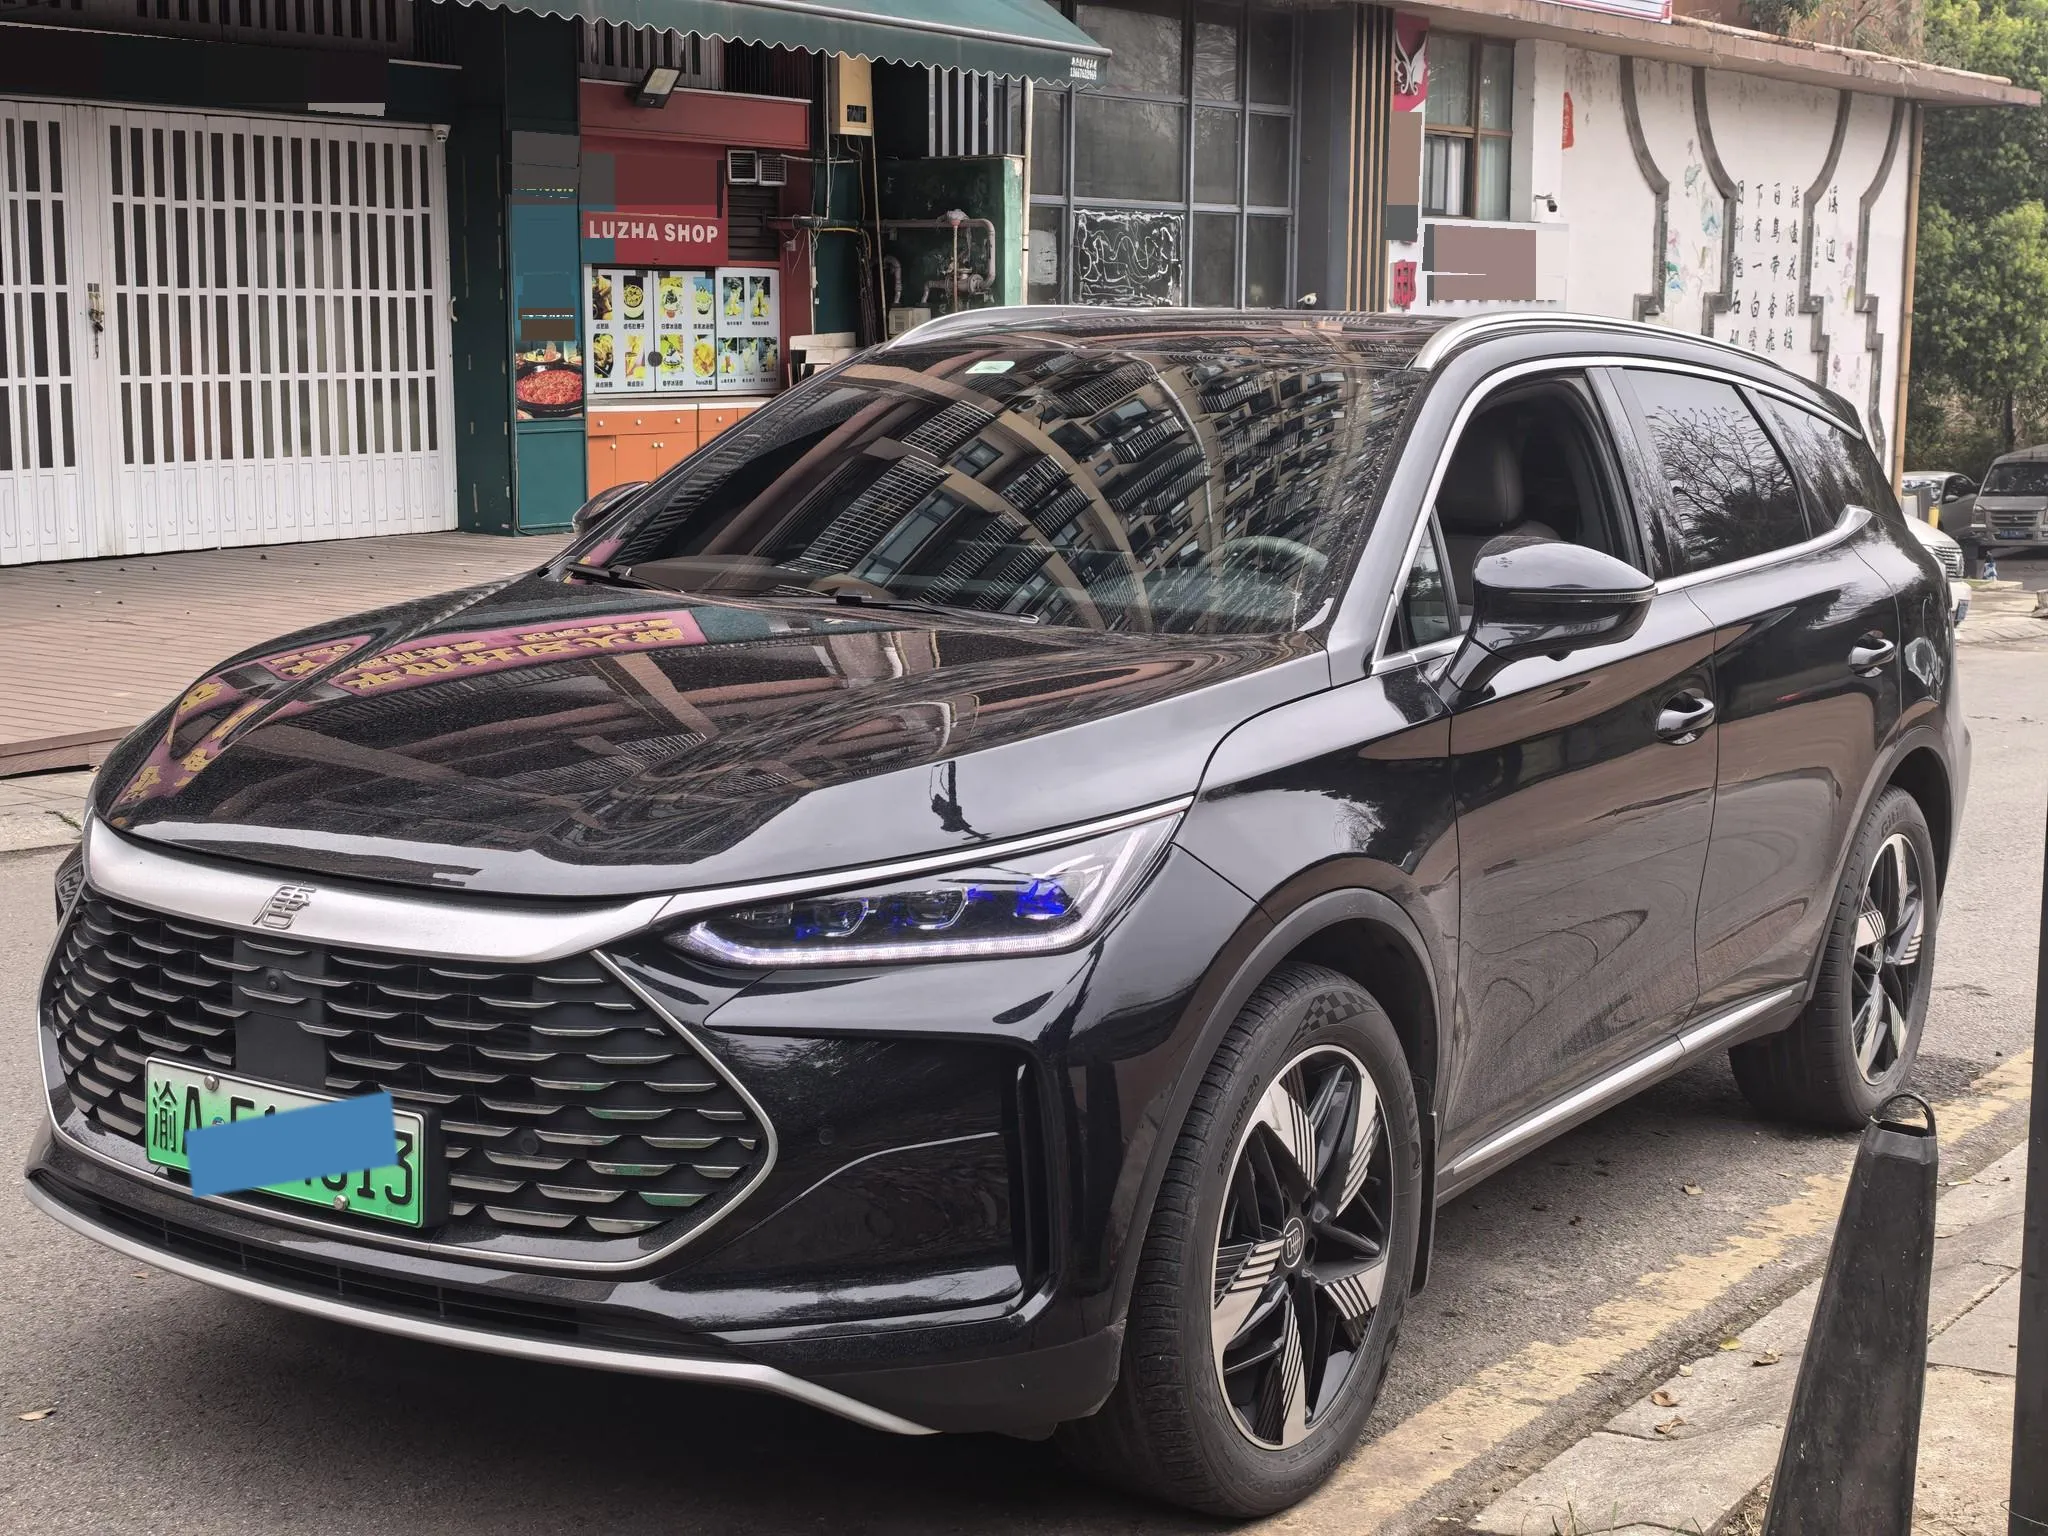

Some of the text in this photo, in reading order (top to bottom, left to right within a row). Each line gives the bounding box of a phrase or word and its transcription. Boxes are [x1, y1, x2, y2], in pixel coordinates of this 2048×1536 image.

[589, 220, 719, 243] LUZHA SHOP
[253, 884, 317, 930] 唐
